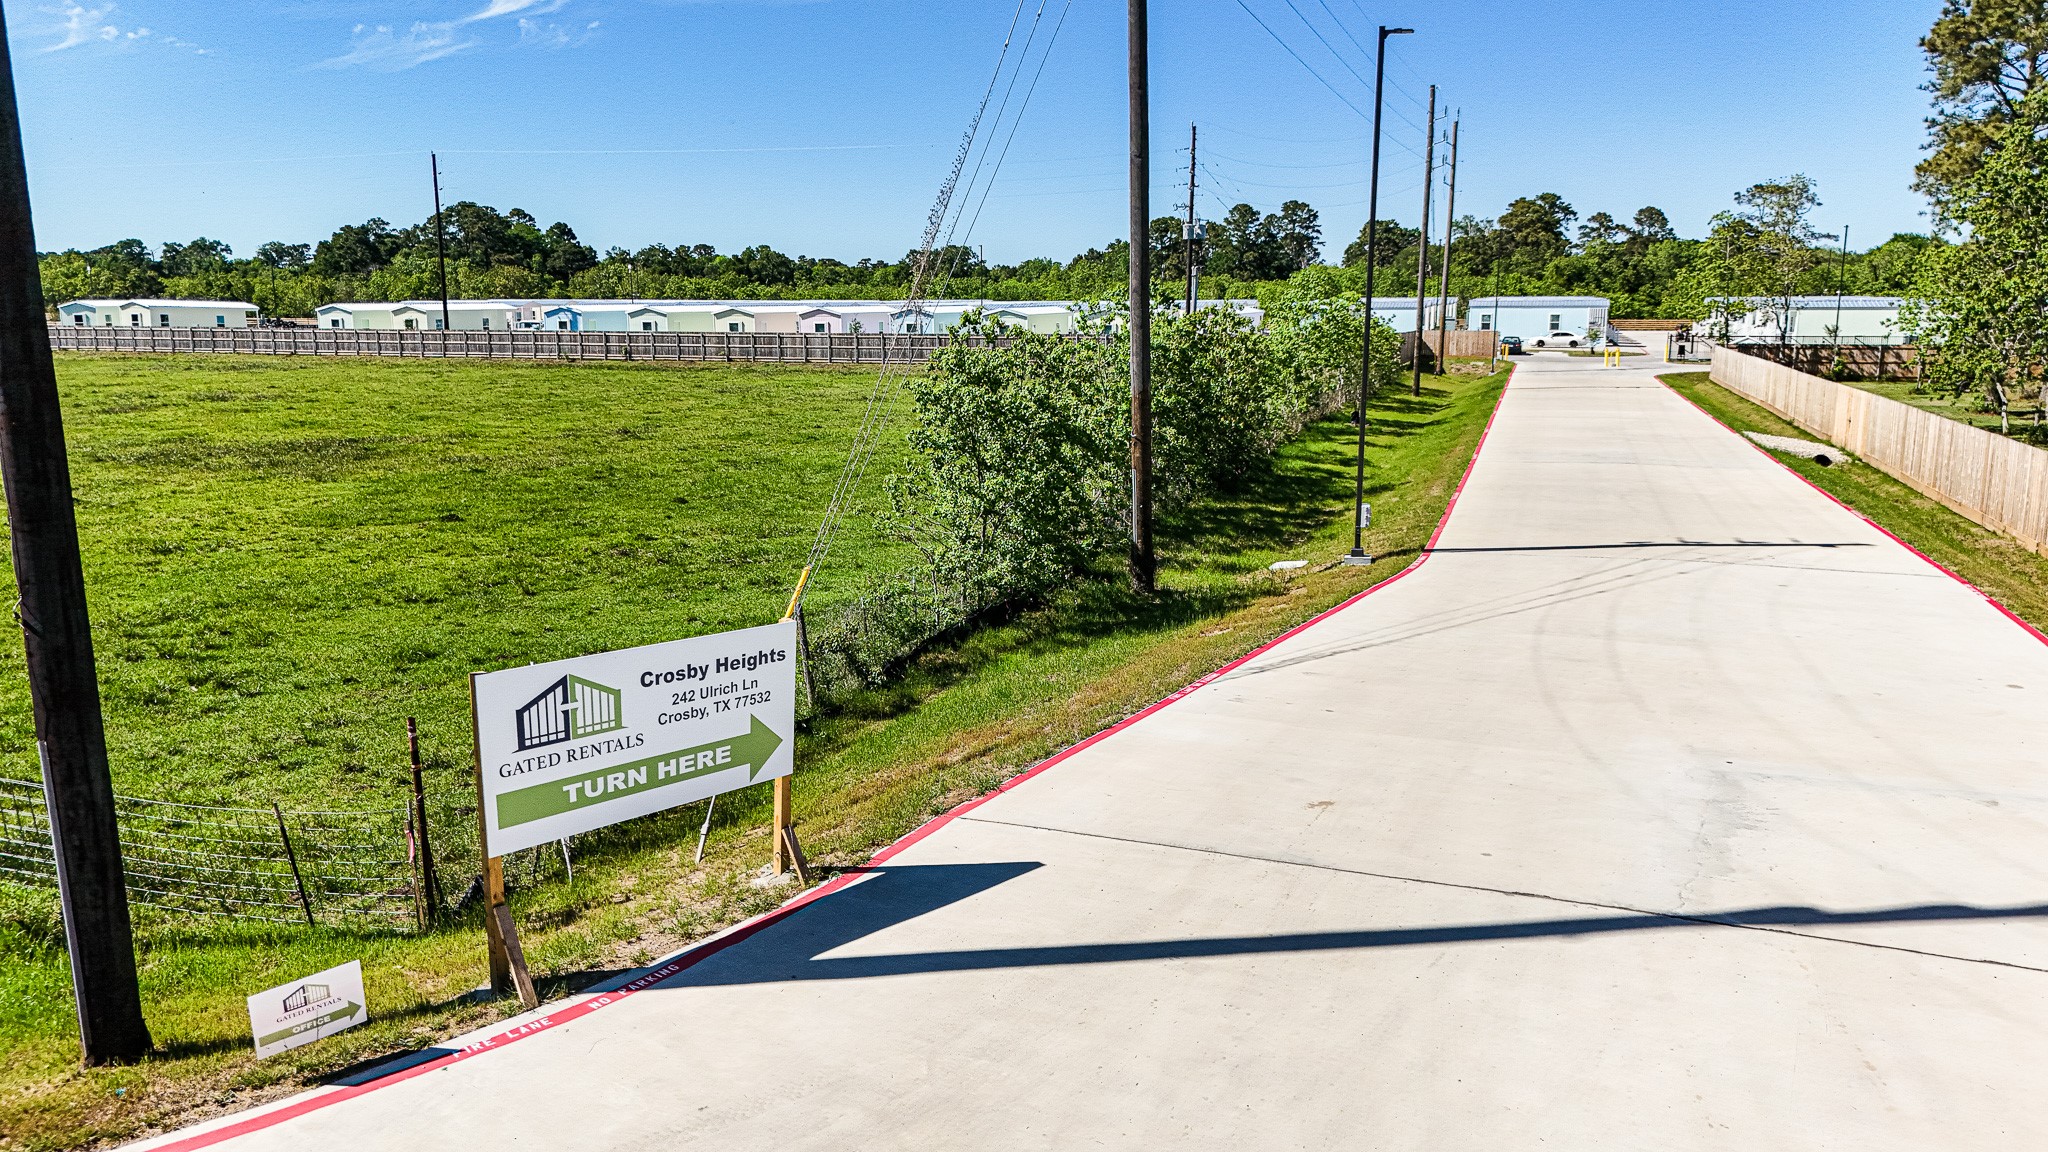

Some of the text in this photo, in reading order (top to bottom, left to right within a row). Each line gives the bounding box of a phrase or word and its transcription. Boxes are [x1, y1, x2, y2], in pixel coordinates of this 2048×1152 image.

[640, 648, 786, 688] Crosby Heights
[658, 690, 771, 726] Crosby, TX 77532
[672, 678, 758, 705] 242 Ulrich Ln
[499, 733, 645, 778] GATED RENTALS
[563, 745, 732, 803] TURN HERE
[276, 997, 342, 1023] GATED RENTALS
[292, 1015, 331, 1033] OFFICE
[452, 963, 680, 1059] FIRE LANE NO PARKING
